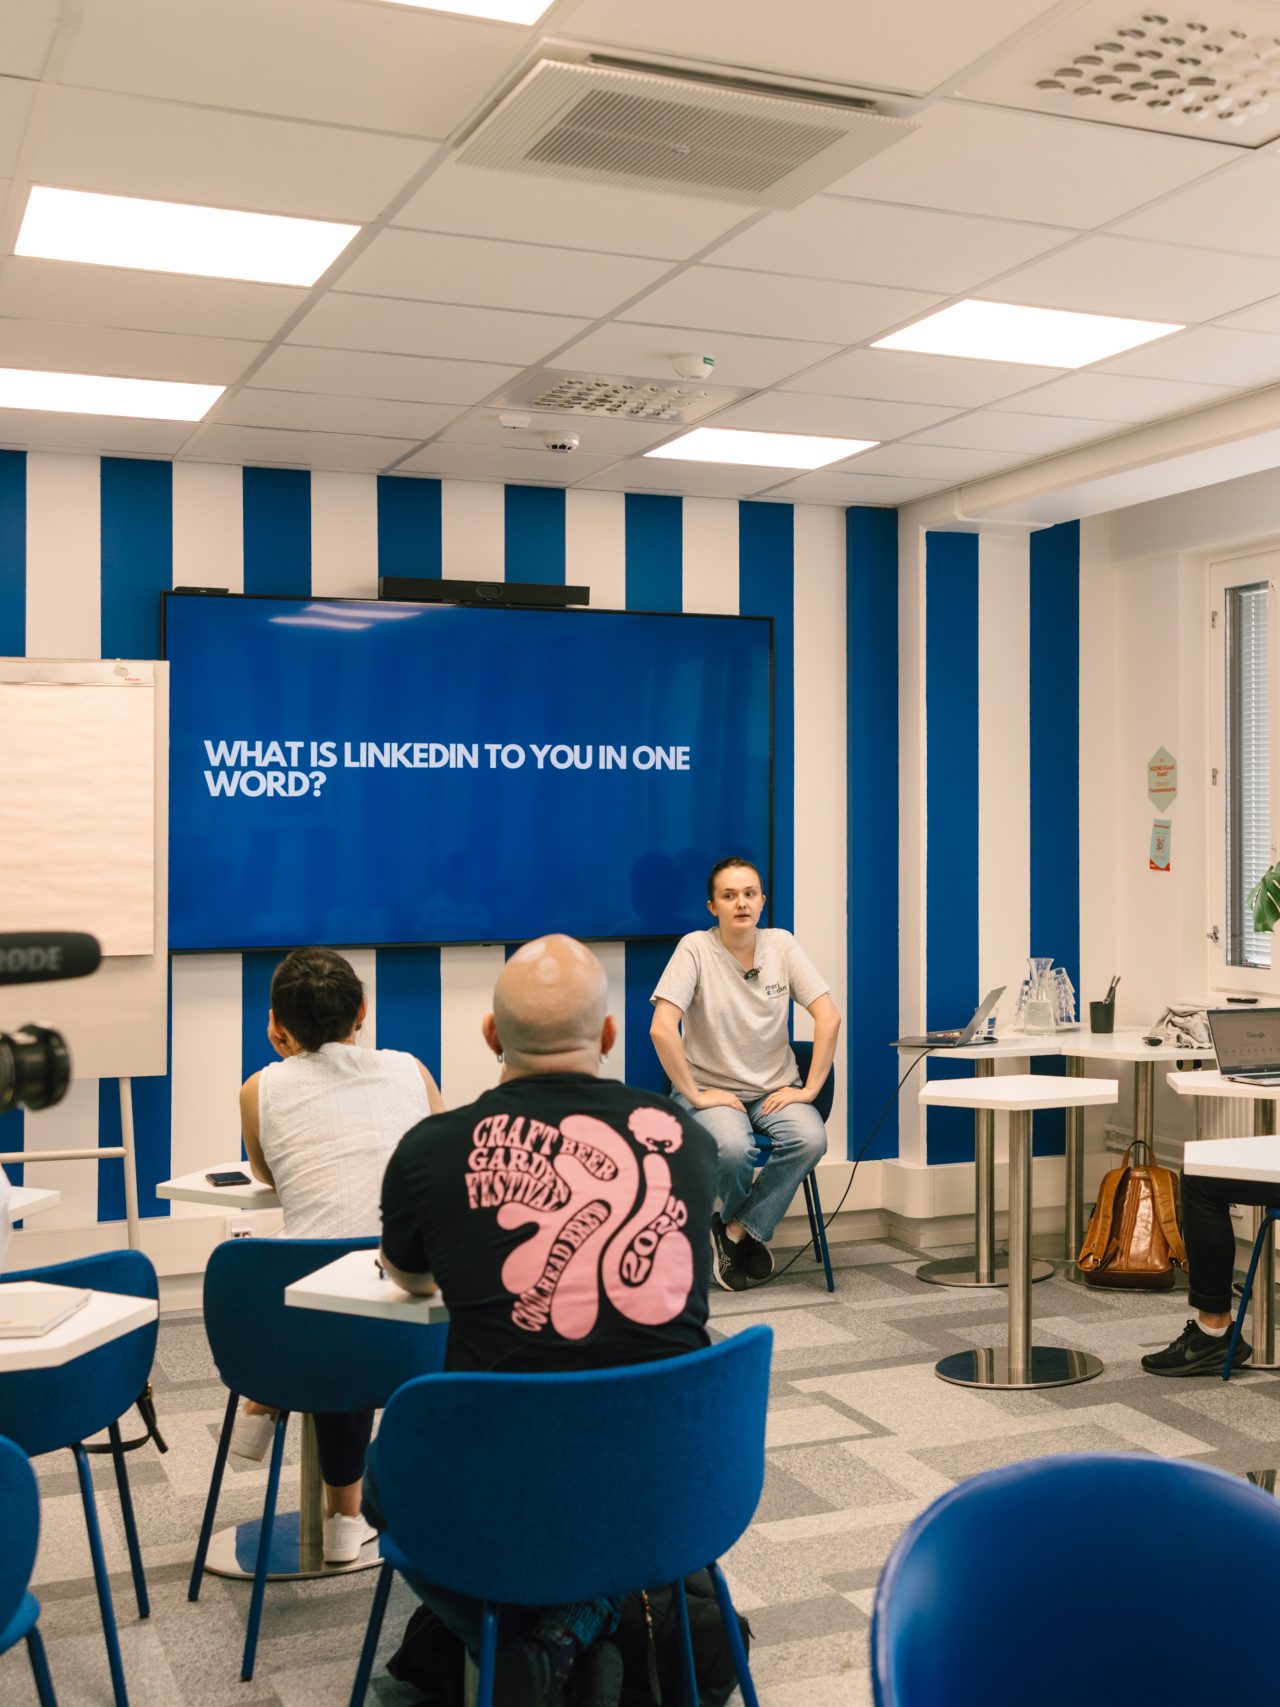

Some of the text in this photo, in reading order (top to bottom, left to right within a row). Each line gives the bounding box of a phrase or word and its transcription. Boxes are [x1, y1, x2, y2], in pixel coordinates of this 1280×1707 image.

[204, 740, 690, 769] WHAT IS LINKEDIN TO YOU IN ONE
[203, 770, 327, 797] WORD?
[473, 1113, 617, 1180] CRAFT BEER
[465, 1170, 560, 1210] FESTIVAL
[468, 1147, 569, 1203] GARDEN
[622, 1196, 688, 1283] 2025
